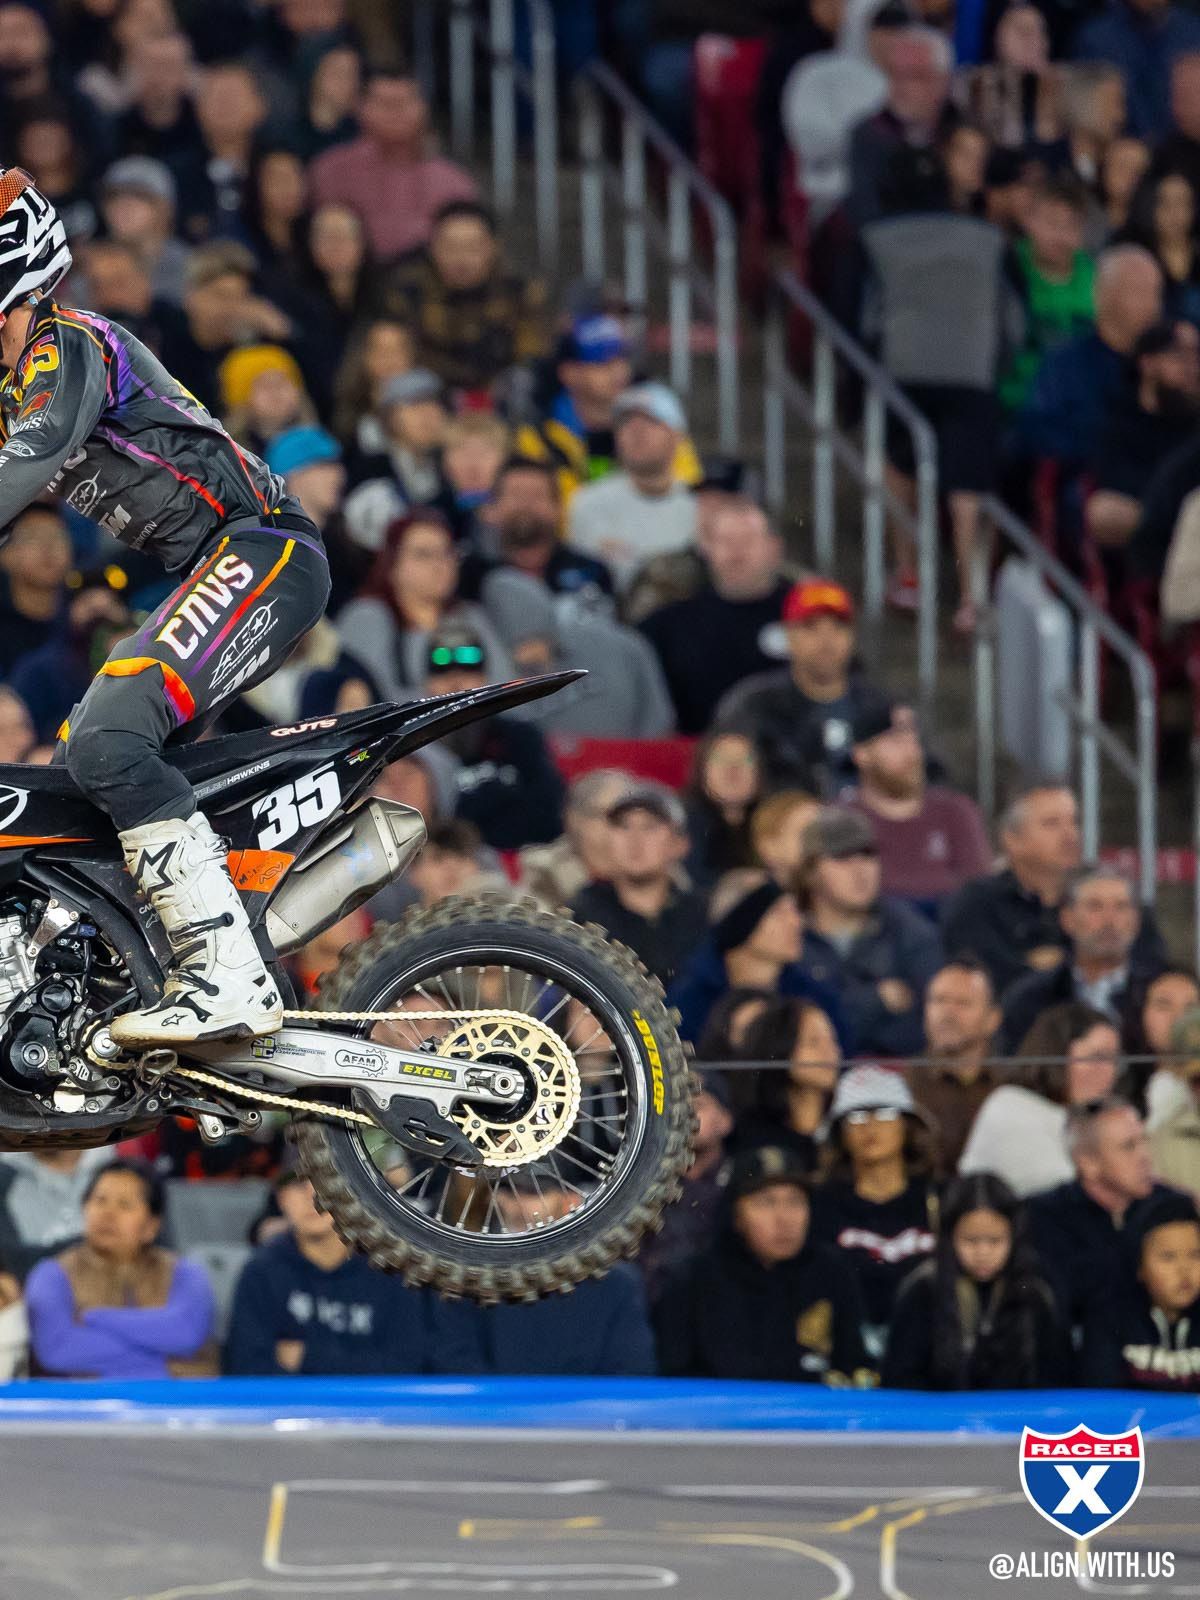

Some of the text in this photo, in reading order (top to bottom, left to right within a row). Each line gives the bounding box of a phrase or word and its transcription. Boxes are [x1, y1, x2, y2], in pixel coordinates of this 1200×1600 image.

[98, 504, 132, 538] TM
[270, 718, 338, 737] GUTS
[227, 760, 270, 785] HAWKINS
[251, 761, 342, 851] 35
[342, 1054, 377, 1066] AFAM
[403, 1063, 453, 1080] EXCEL
